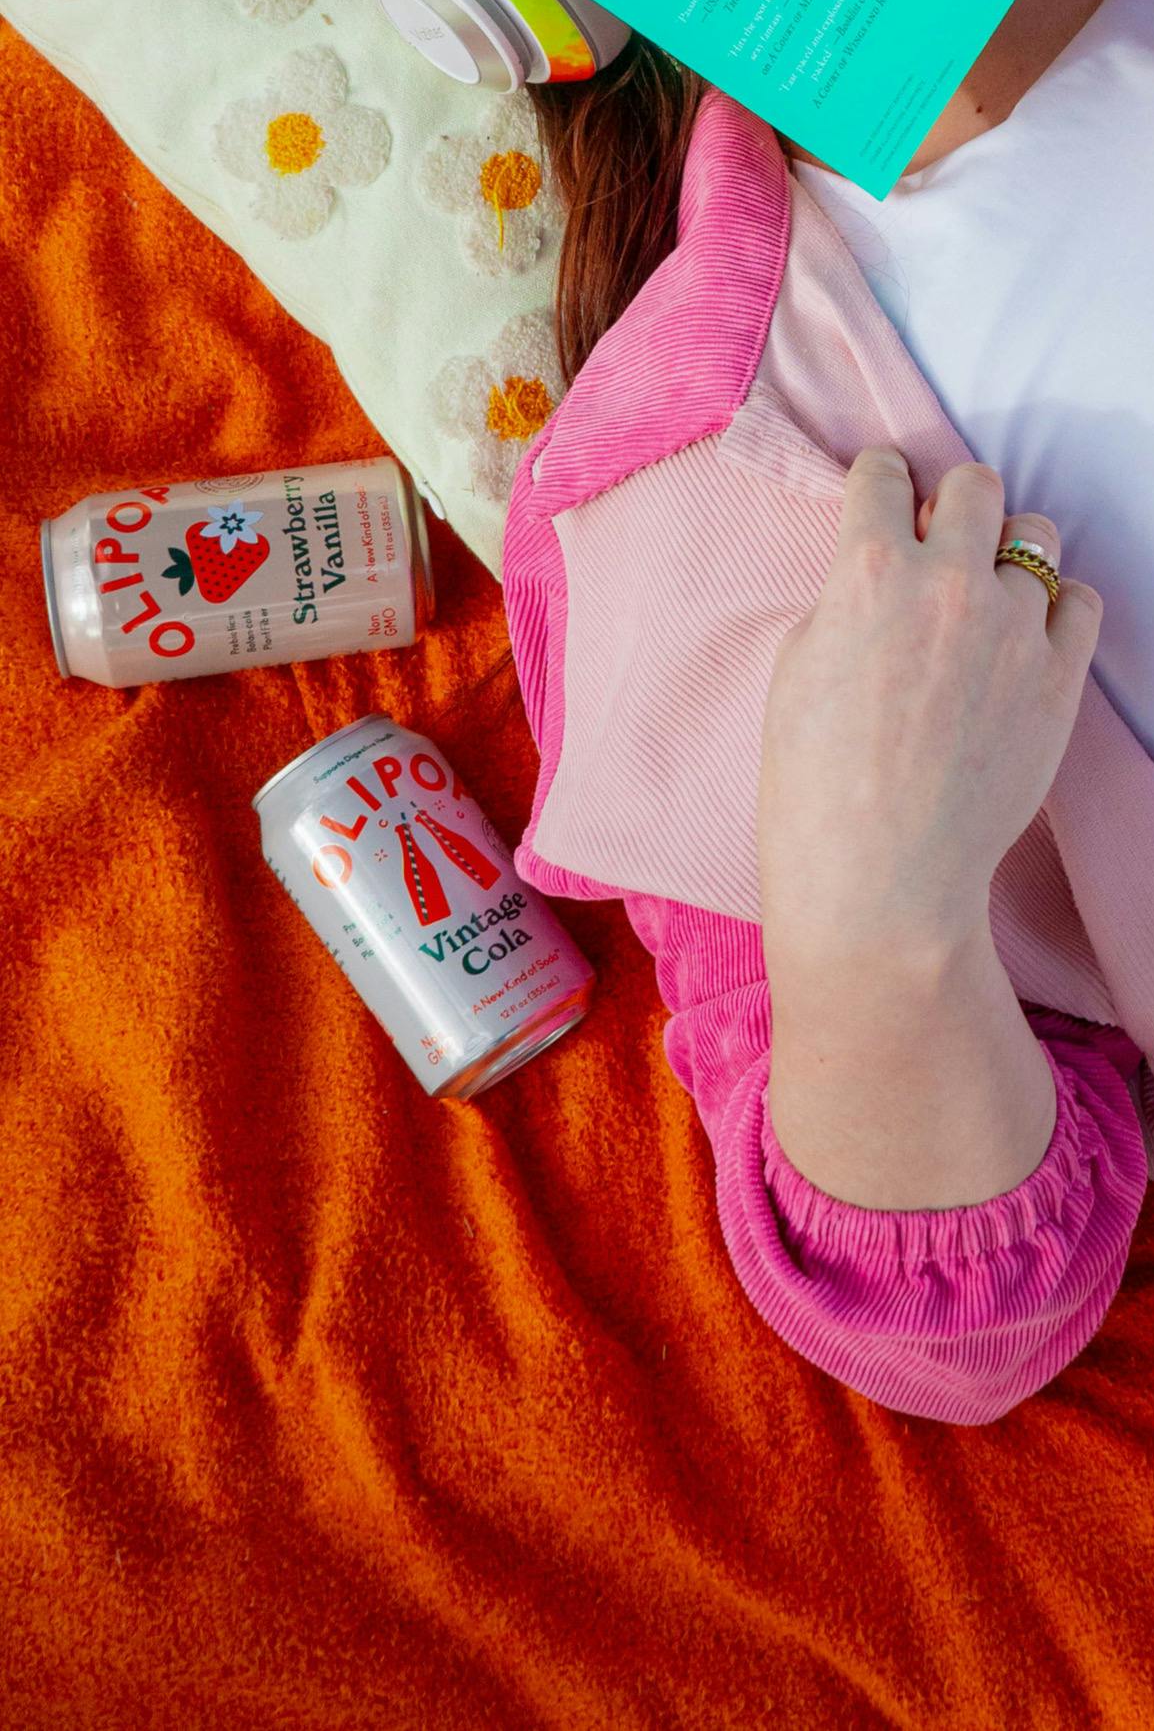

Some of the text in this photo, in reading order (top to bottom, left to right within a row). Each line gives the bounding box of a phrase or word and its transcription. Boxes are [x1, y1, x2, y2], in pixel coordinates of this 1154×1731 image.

[358, 510, 370, 521] of
[313, 489, 346, 595] Vanilla
[360, 522, 373, 547] Kind
[282, 475, 319, 627] Strawberry
[365, 548, 377, 572] New
[367, 573, 378, 583] A
[368, 615, 382, 636] Non
[382, 607, 398, 636] GMO
[418, 891, 528, 963] Vintage
[462, 928, 534, 975] Cola
[472, 1004, 481, 1015] A
[480, 989, 504, 1007] New
[504, 970, 528, 991] Kind
[528, 962, 539, 975] of
